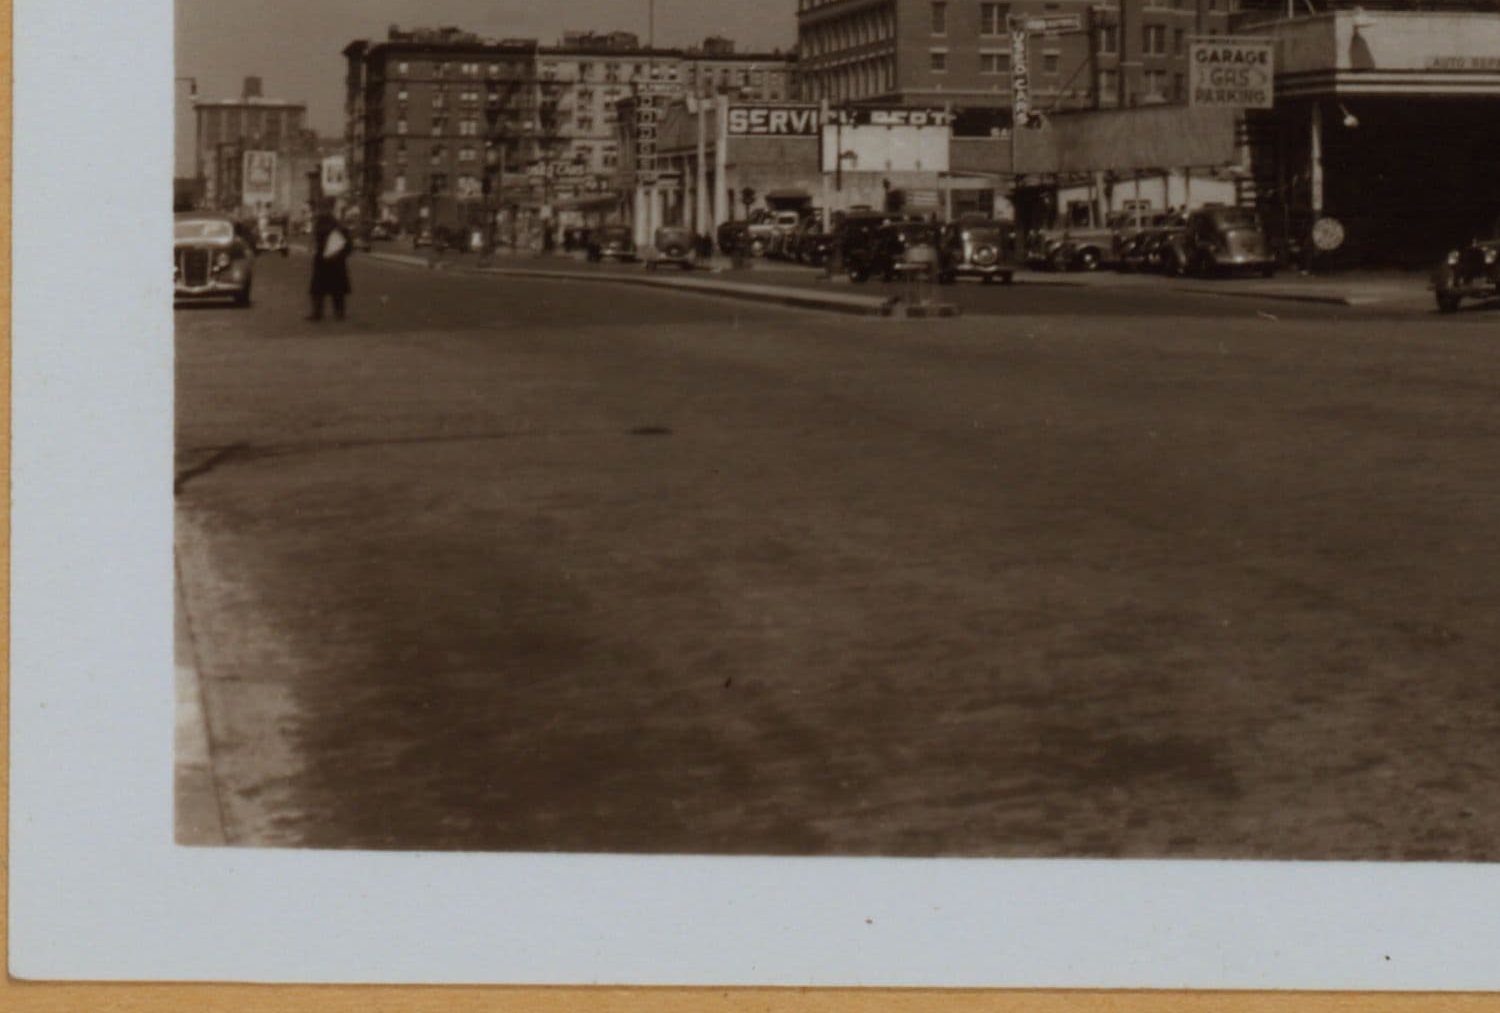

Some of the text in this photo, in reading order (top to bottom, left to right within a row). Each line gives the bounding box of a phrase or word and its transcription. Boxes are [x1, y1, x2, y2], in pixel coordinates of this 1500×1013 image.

[1195, 48, 1267, 65] GARAGE
[1211, 68, 1250, 87] GAS
[1195, 88, 1265, 104] PARKING
